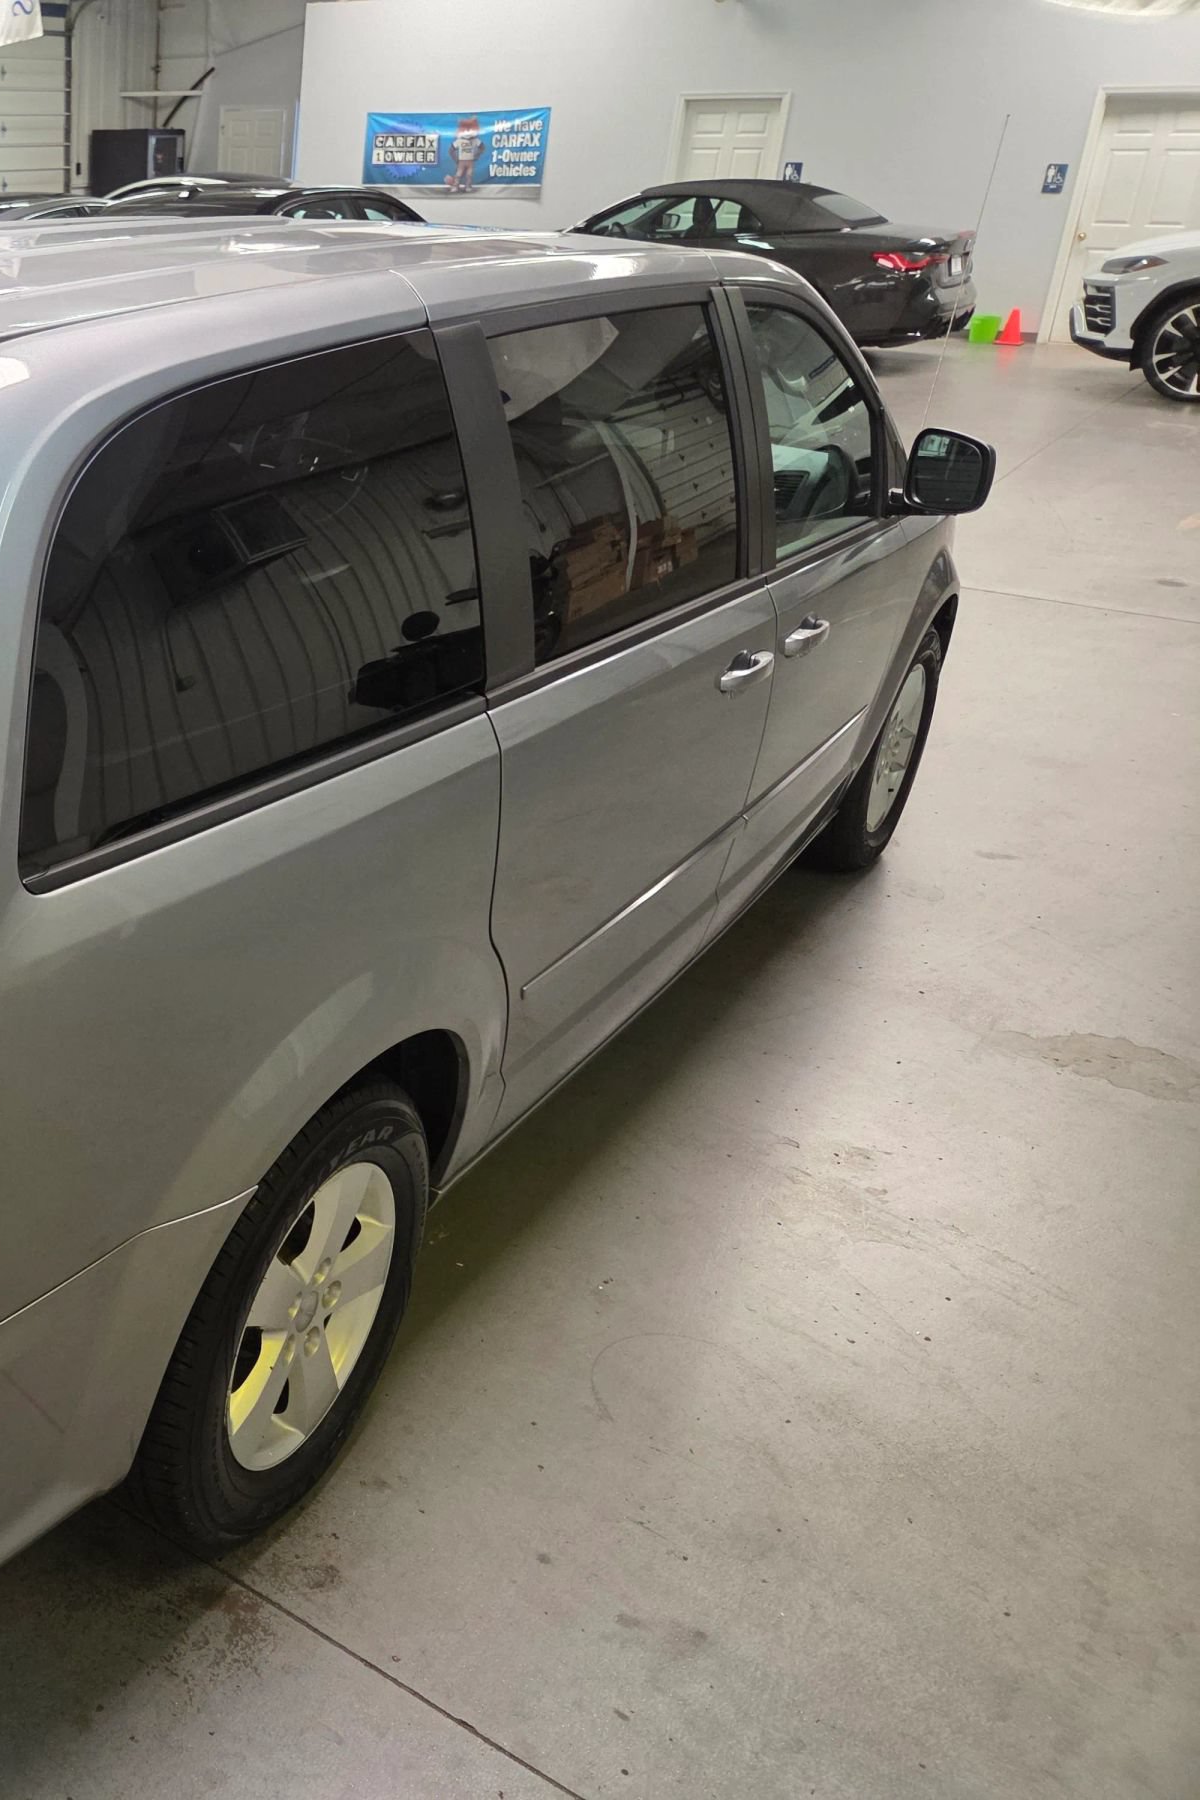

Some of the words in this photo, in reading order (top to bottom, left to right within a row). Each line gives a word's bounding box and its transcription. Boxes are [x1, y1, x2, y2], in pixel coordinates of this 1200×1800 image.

[494, 120, 512, 132] We
[514, 119, 543, 132] have
[375, 136, 435, 149] CARFAX
[492, 132, 541, 148] CARFAX
[491, 149, 541, 162] 1-Owner
[489, 163, 537, 177] Vehicles
